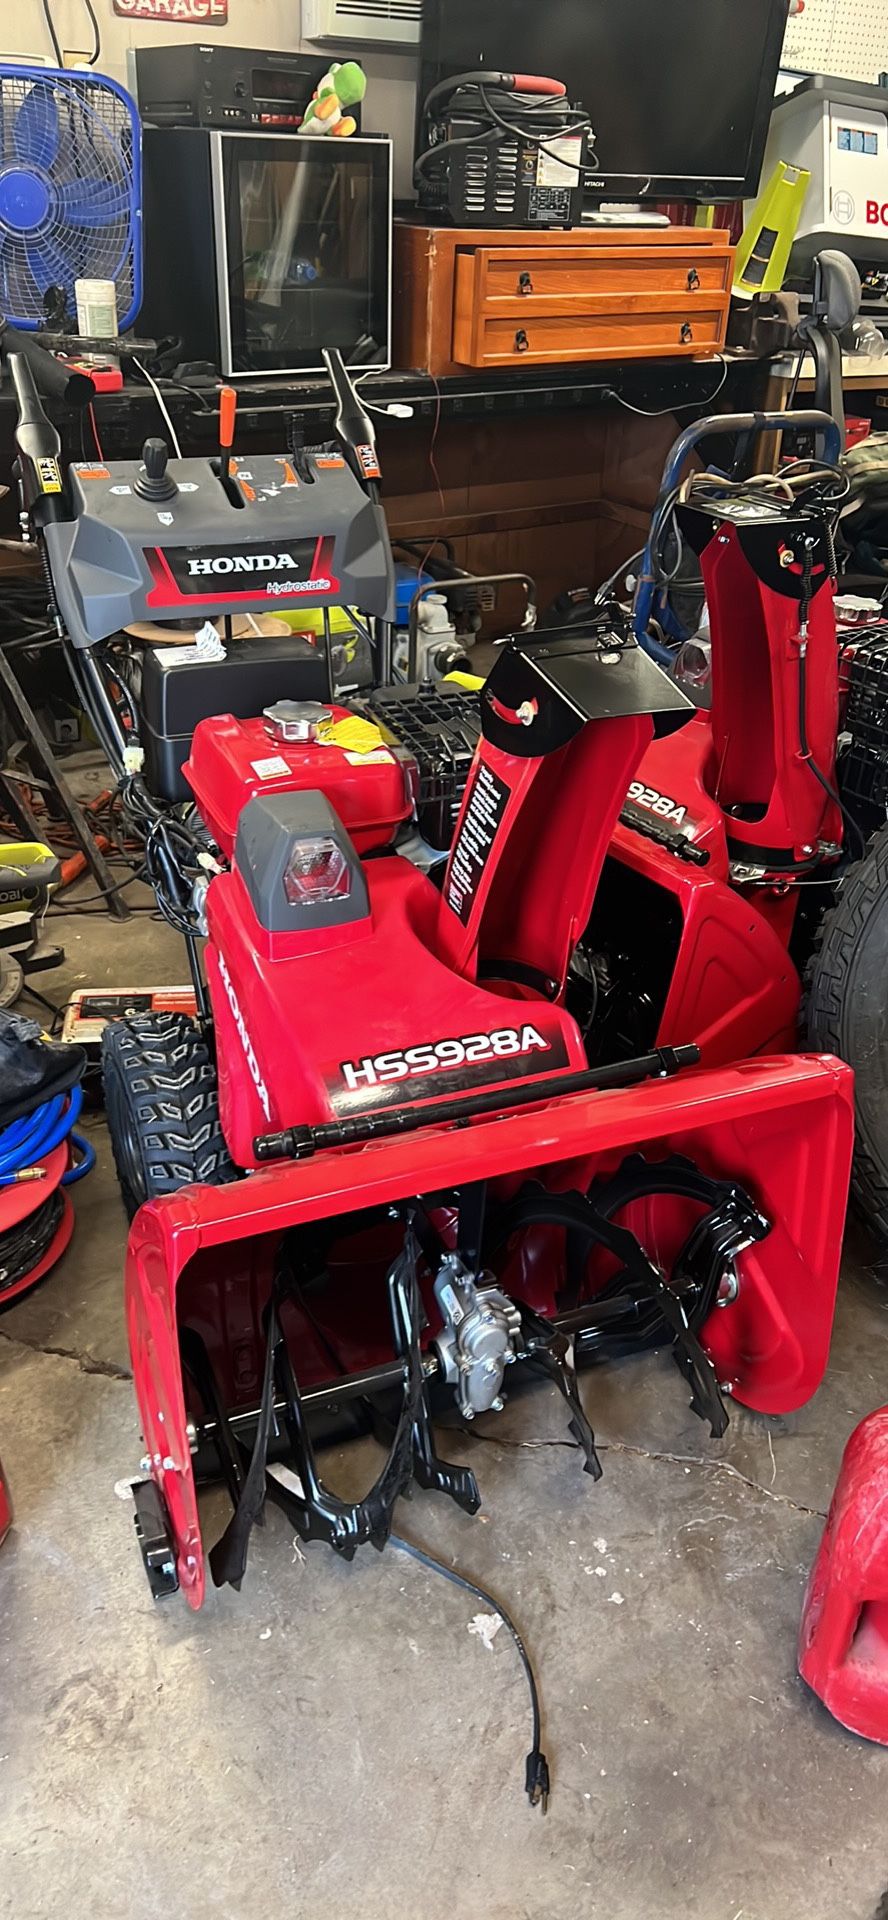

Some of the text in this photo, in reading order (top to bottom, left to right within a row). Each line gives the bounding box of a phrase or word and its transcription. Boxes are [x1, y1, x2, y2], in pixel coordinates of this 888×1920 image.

[187, 553, 299, 576] HONDA
[266, 578, 331, 595] Hydrostatic
[626, 782, 686, 825] 928A
[218, 949, 271, 1122] HONDA
[342, 1026, 548, 1088] HSS928A
